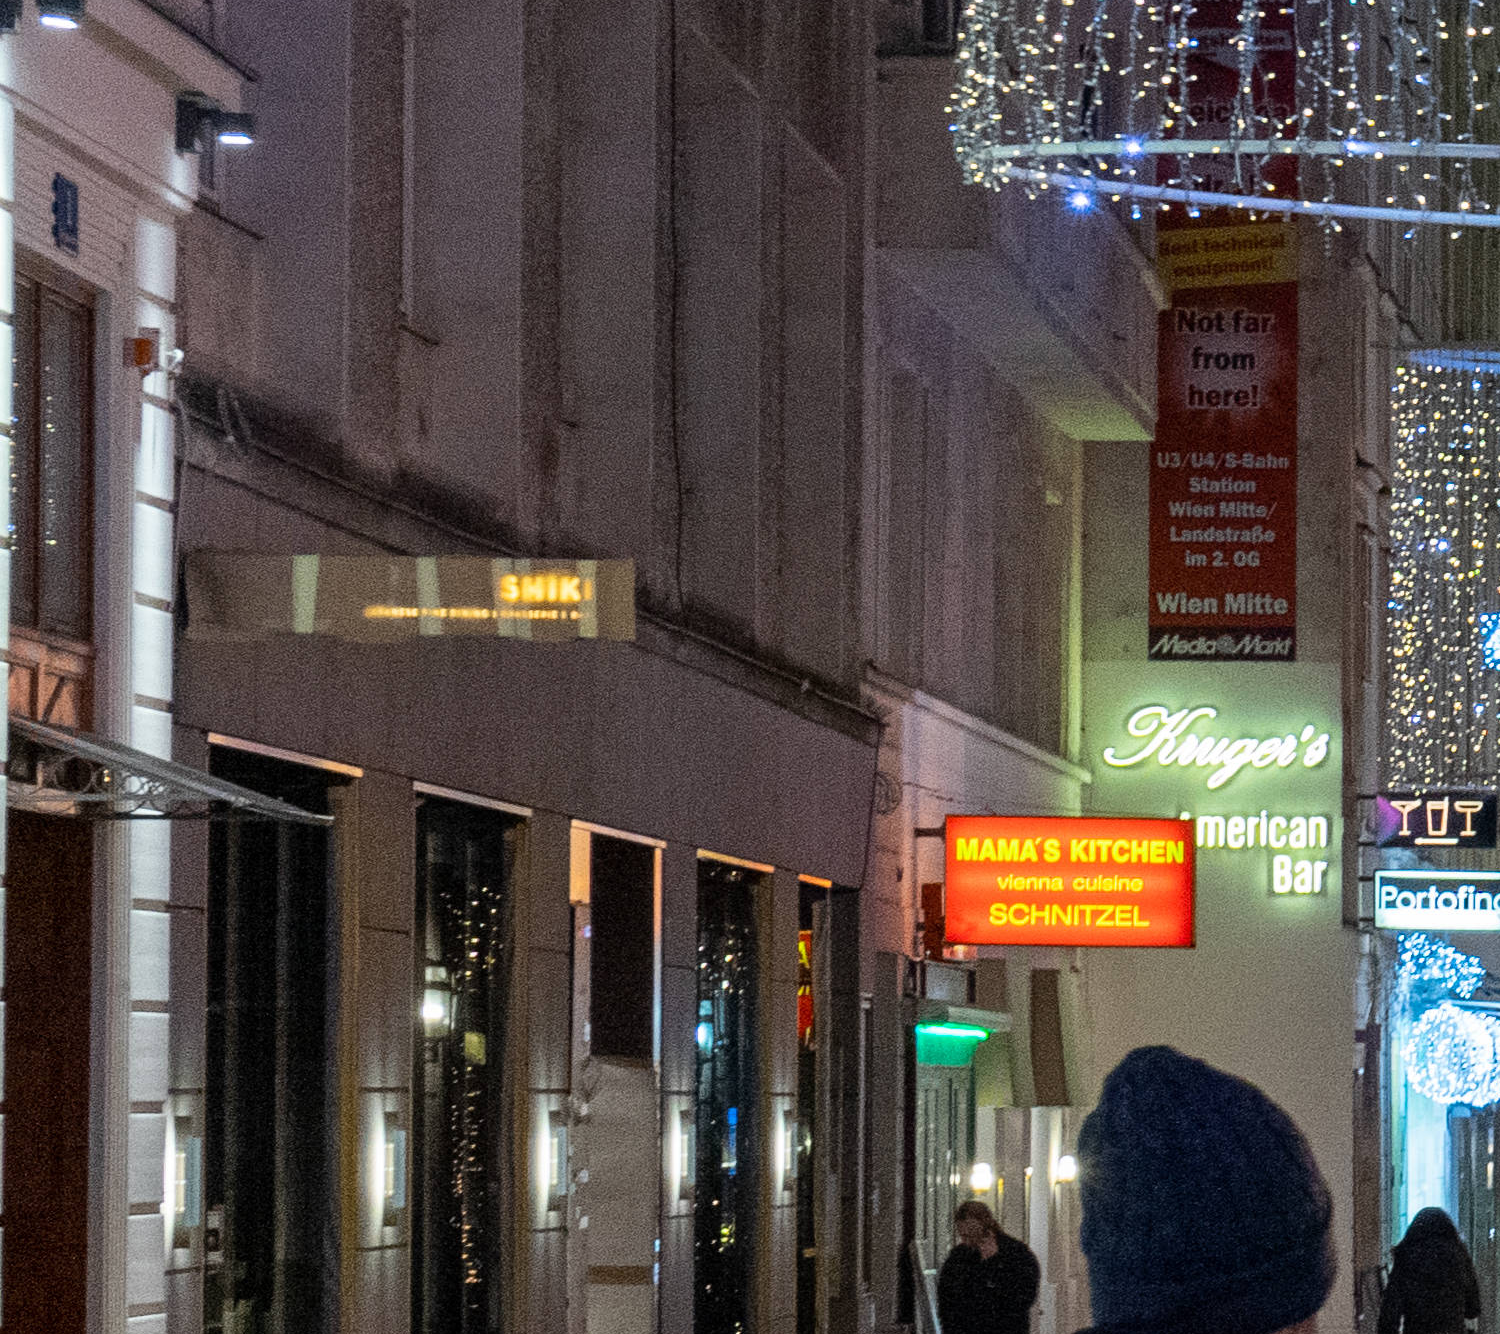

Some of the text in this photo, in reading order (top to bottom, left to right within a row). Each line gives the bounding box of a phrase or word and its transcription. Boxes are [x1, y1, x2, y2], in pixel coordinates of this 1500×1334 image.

[1176, 307, 1275, 334] Not far
[1191, 346, 1257, 371] from
[1188, 384, 1260, 408] here!
[1188, 477, 1257, 494] Station
[1168, 501, 1278, 520] Wien Mitte/
[1169, 524, 1276, 545] Landstraße
[1185, 550, 1261, 568] im 2. OG
[1155, 591, 1290, 616] Wien Mitte
[1103, 704, 1330, 790] Kruger's
[1179, 809, 1329, 850] merican
[1070, 839, 1185, 864] KITCHEN
[996, 874, 1145, 893] vienna cuisine
[1272, 853, 1330, 895] Bar
[989, 903, 1150, 928] SCHNITZEL
